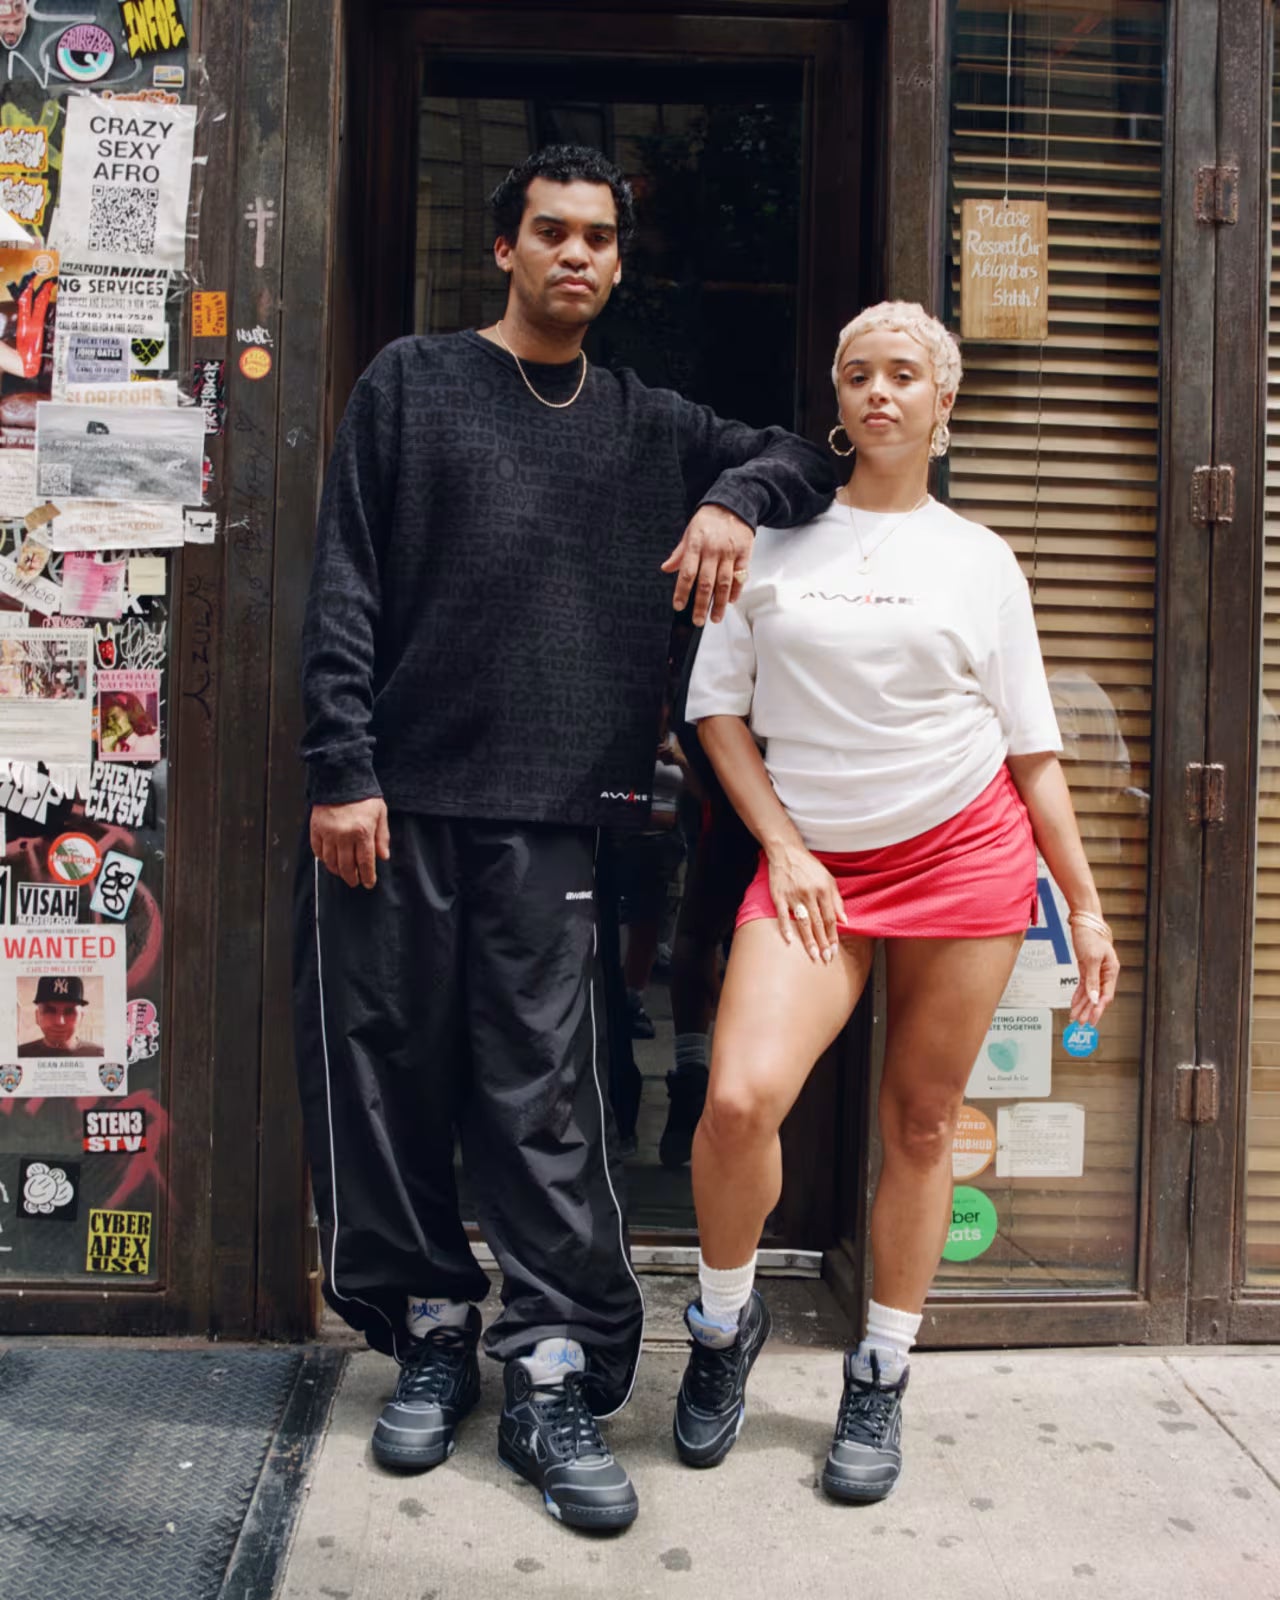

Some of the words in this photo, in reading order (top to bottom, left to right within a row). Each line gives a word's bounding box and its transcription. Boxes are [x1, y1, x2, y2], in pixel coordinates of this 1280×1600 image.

[90, 116, 174, 139] CRAZY
[98, 139, 161, 160] SEXY
[93, 162, 160, 183] AFRO
[976, 205, 1031, 227] Please
[966, 230, 1017, 256] Respect
[1018, 232, 1043, 257] Our
[971, 257, 1038, 286] Neighbors
[89, 280, 163, 296] SERVICES
[90, 762, 153, 799] PHENE
[85, 789, 147, 827] CLYSM
[19, 888, 78, 916] VISAH
[4, 936, 116, 958] WANTED
[1060, 977, 1079, 986] NYC
[1003, 1024, 1042, 1032] TOGETHER
[1016, 1015, 1039, 1023] FOOD
[1067, 1031, 1095, 1045] ADT
[86, 1111, 143, 1136] STEN3
[87, 1136, 142, 1152] STV
[90, 1212, 150, 1235] CYBER
[89, 1235, 147, 1259] AFEX
[91, 1256, 147, 1274] USC
